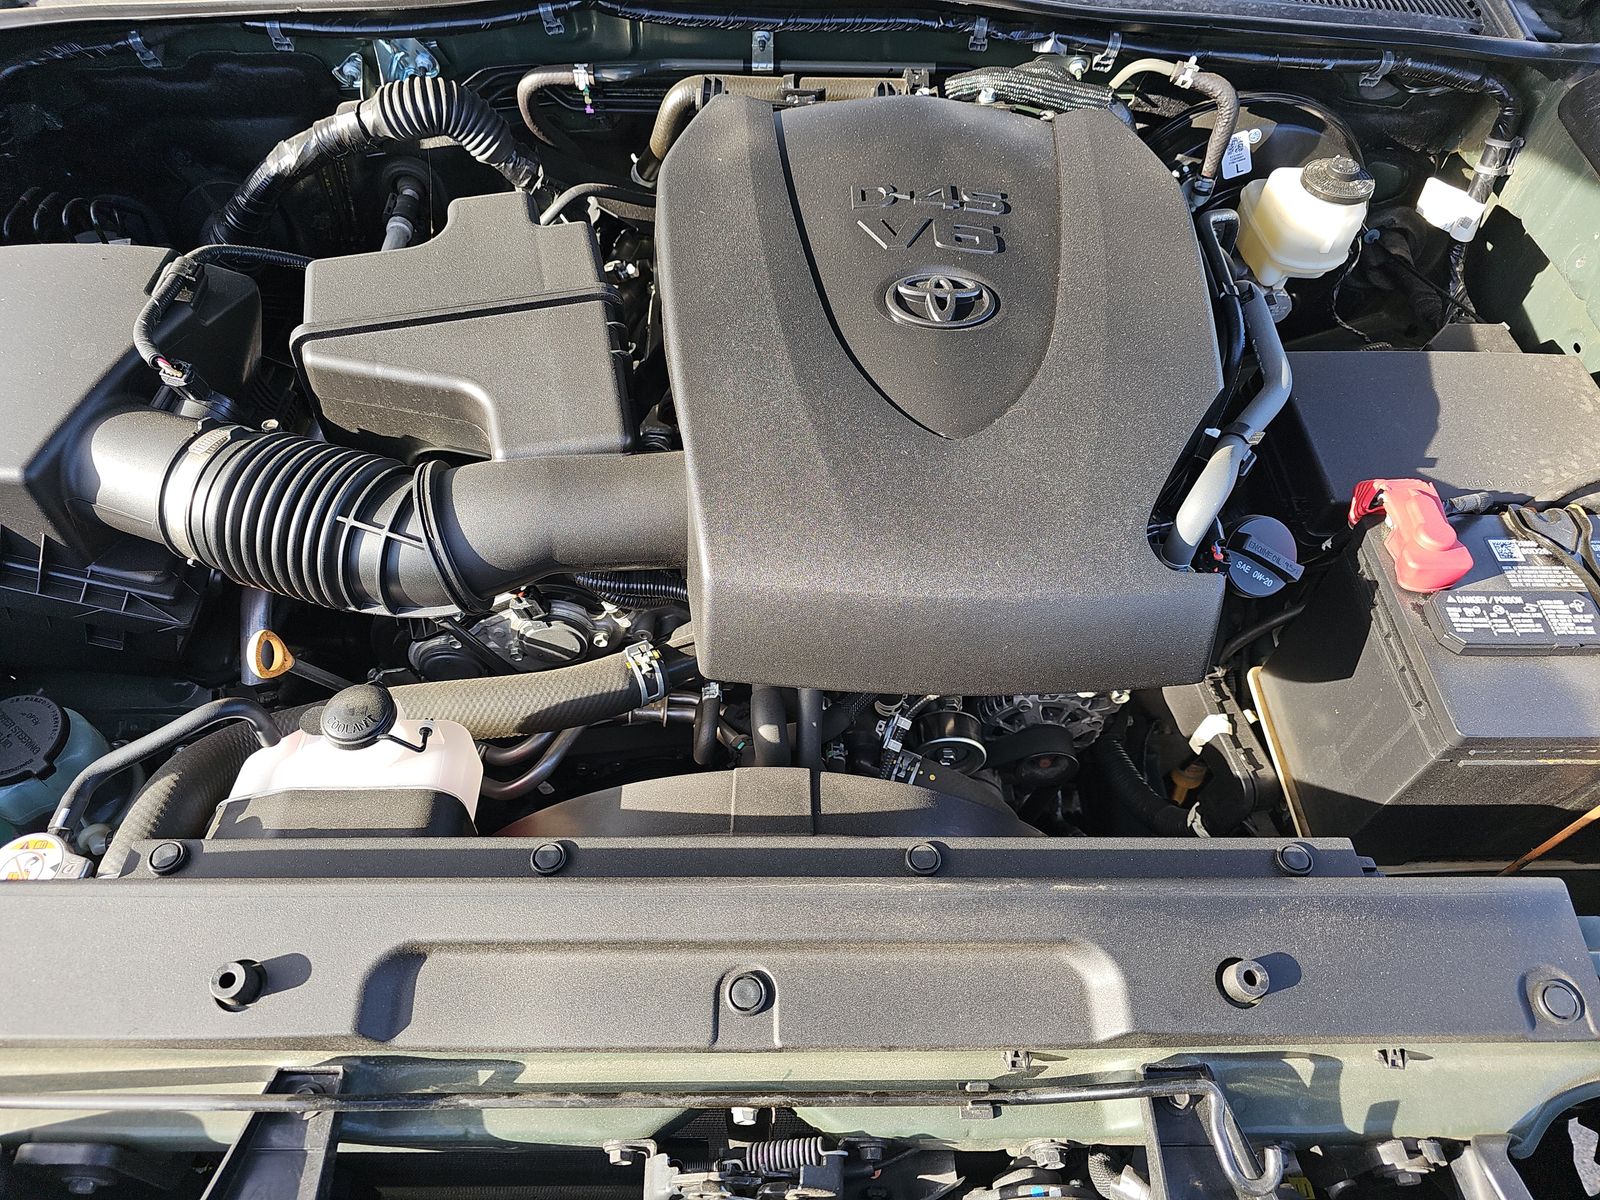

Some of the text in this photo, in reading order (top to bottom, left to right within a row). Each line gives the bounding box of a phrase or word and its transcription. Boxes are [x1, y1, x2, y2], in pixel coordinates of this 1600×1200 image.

[1236, 163, 1244, 174] L
[850, 184, 1012, 216] D-4S
[856, 217, 1006, 255] V6
[1236, 560, 1274, 587] SAE 0W-20
[1455, 595, 1489, 604] DANGER
[1493, 595, 1523, 604] POISON
[327, 715, 376, 733] COOLANT
[11, 725, 41, 755] STEERING
